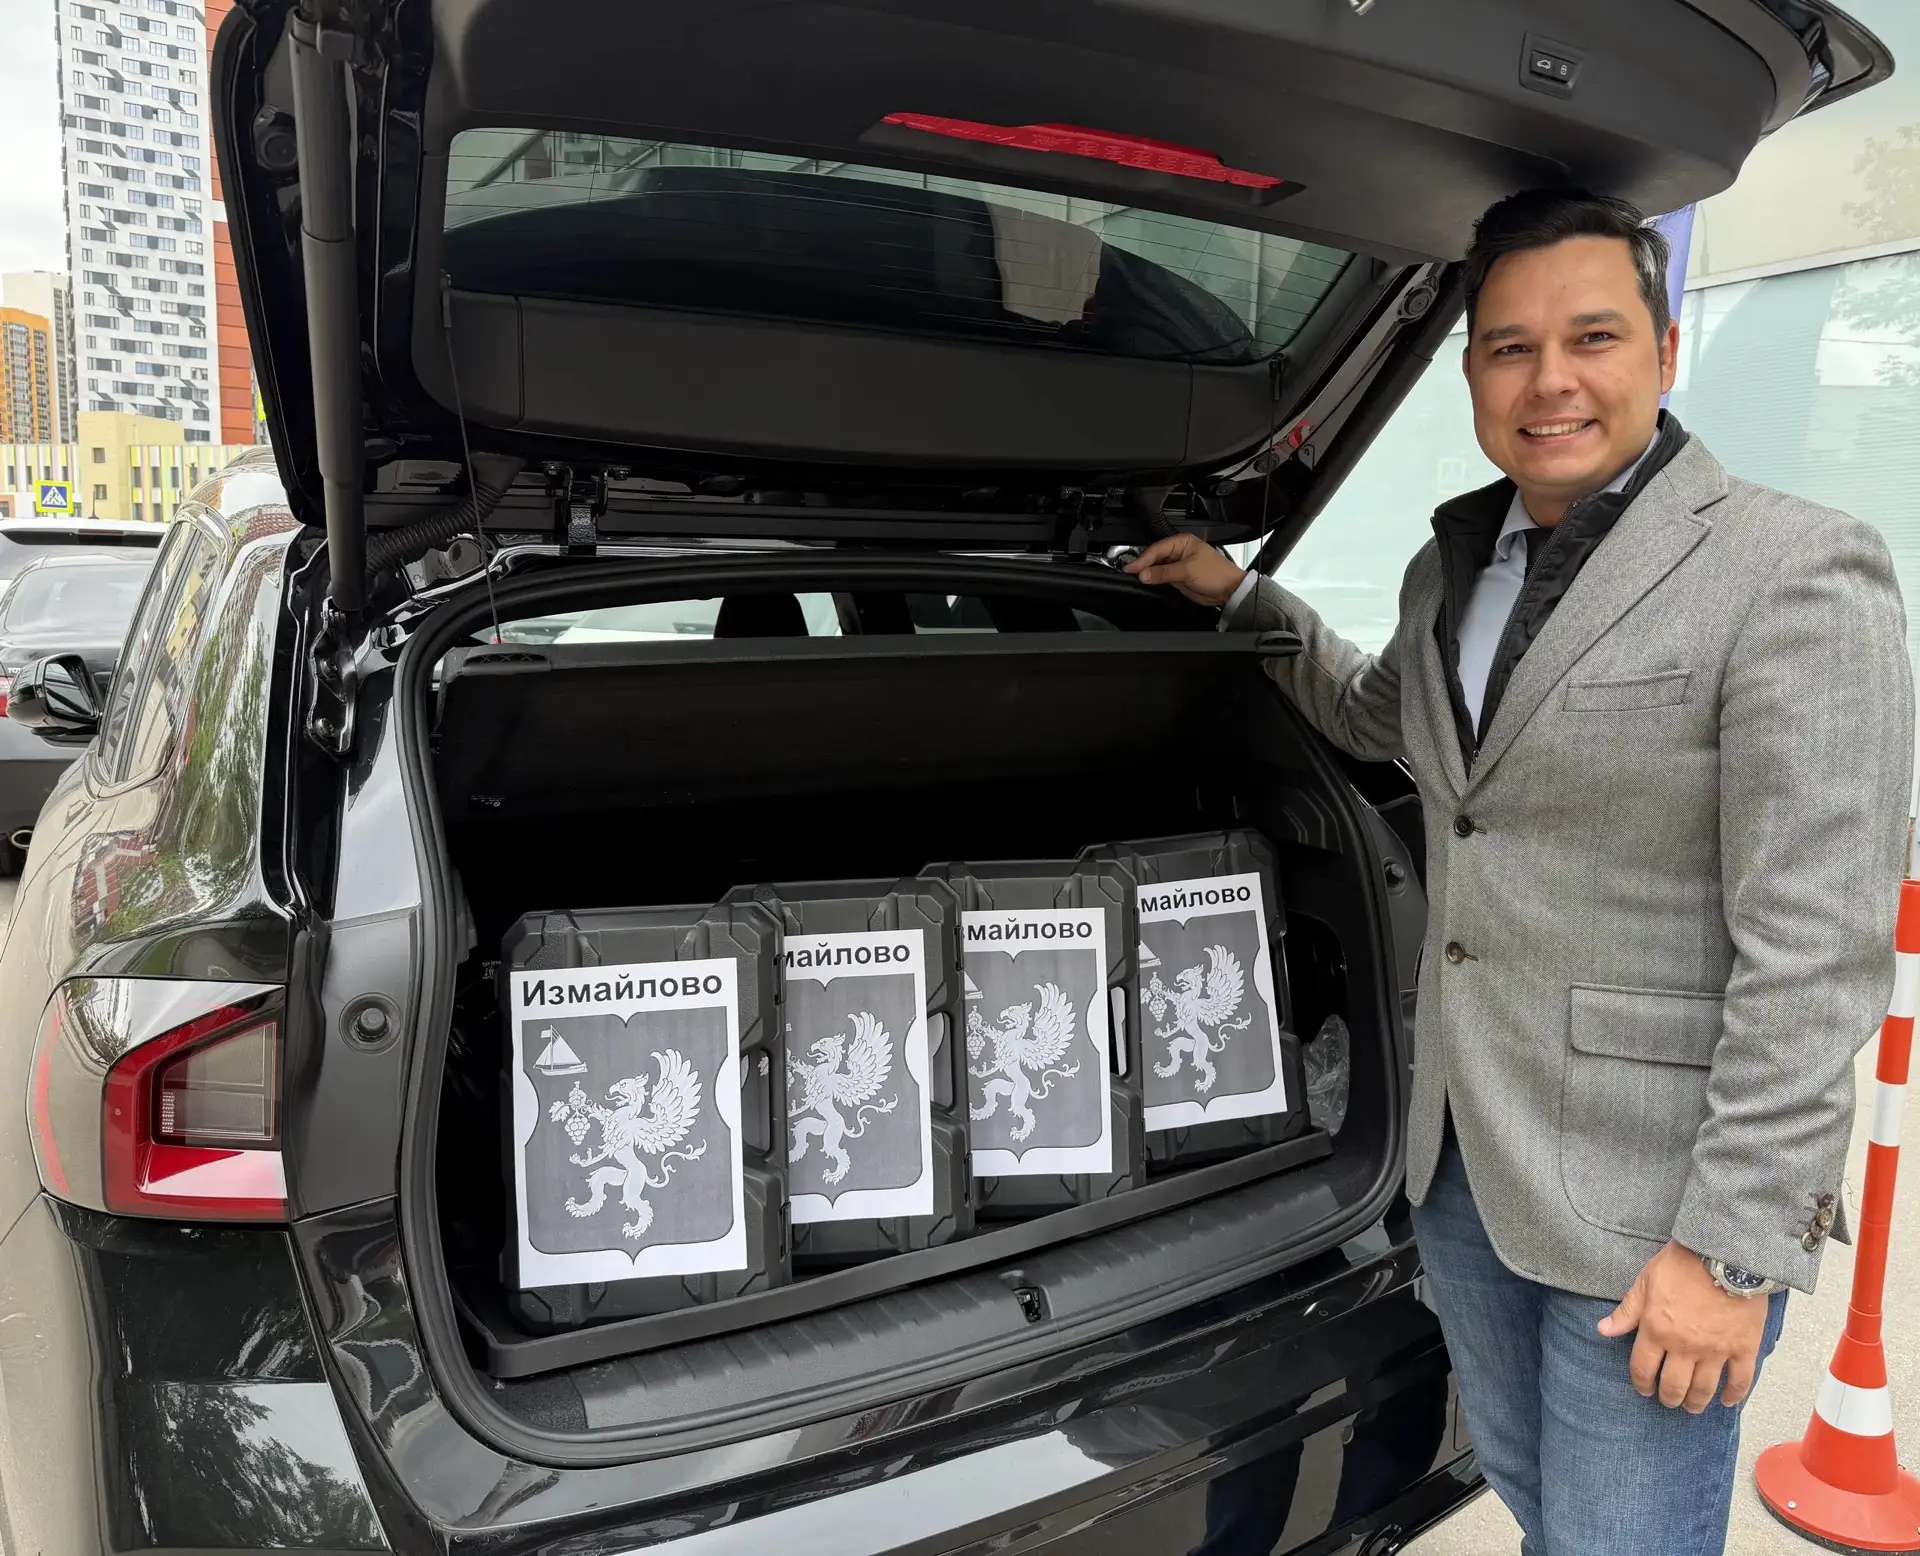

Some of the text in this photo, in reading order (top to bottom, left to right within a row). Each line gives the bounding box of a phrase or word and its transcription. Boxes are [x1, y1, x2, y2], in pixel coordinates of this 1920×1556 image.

[1141, 886, 1251, 912] майлово
[967, 917, 1093, 941] майлово
[523, 973, 722, 1007] Измайлово
